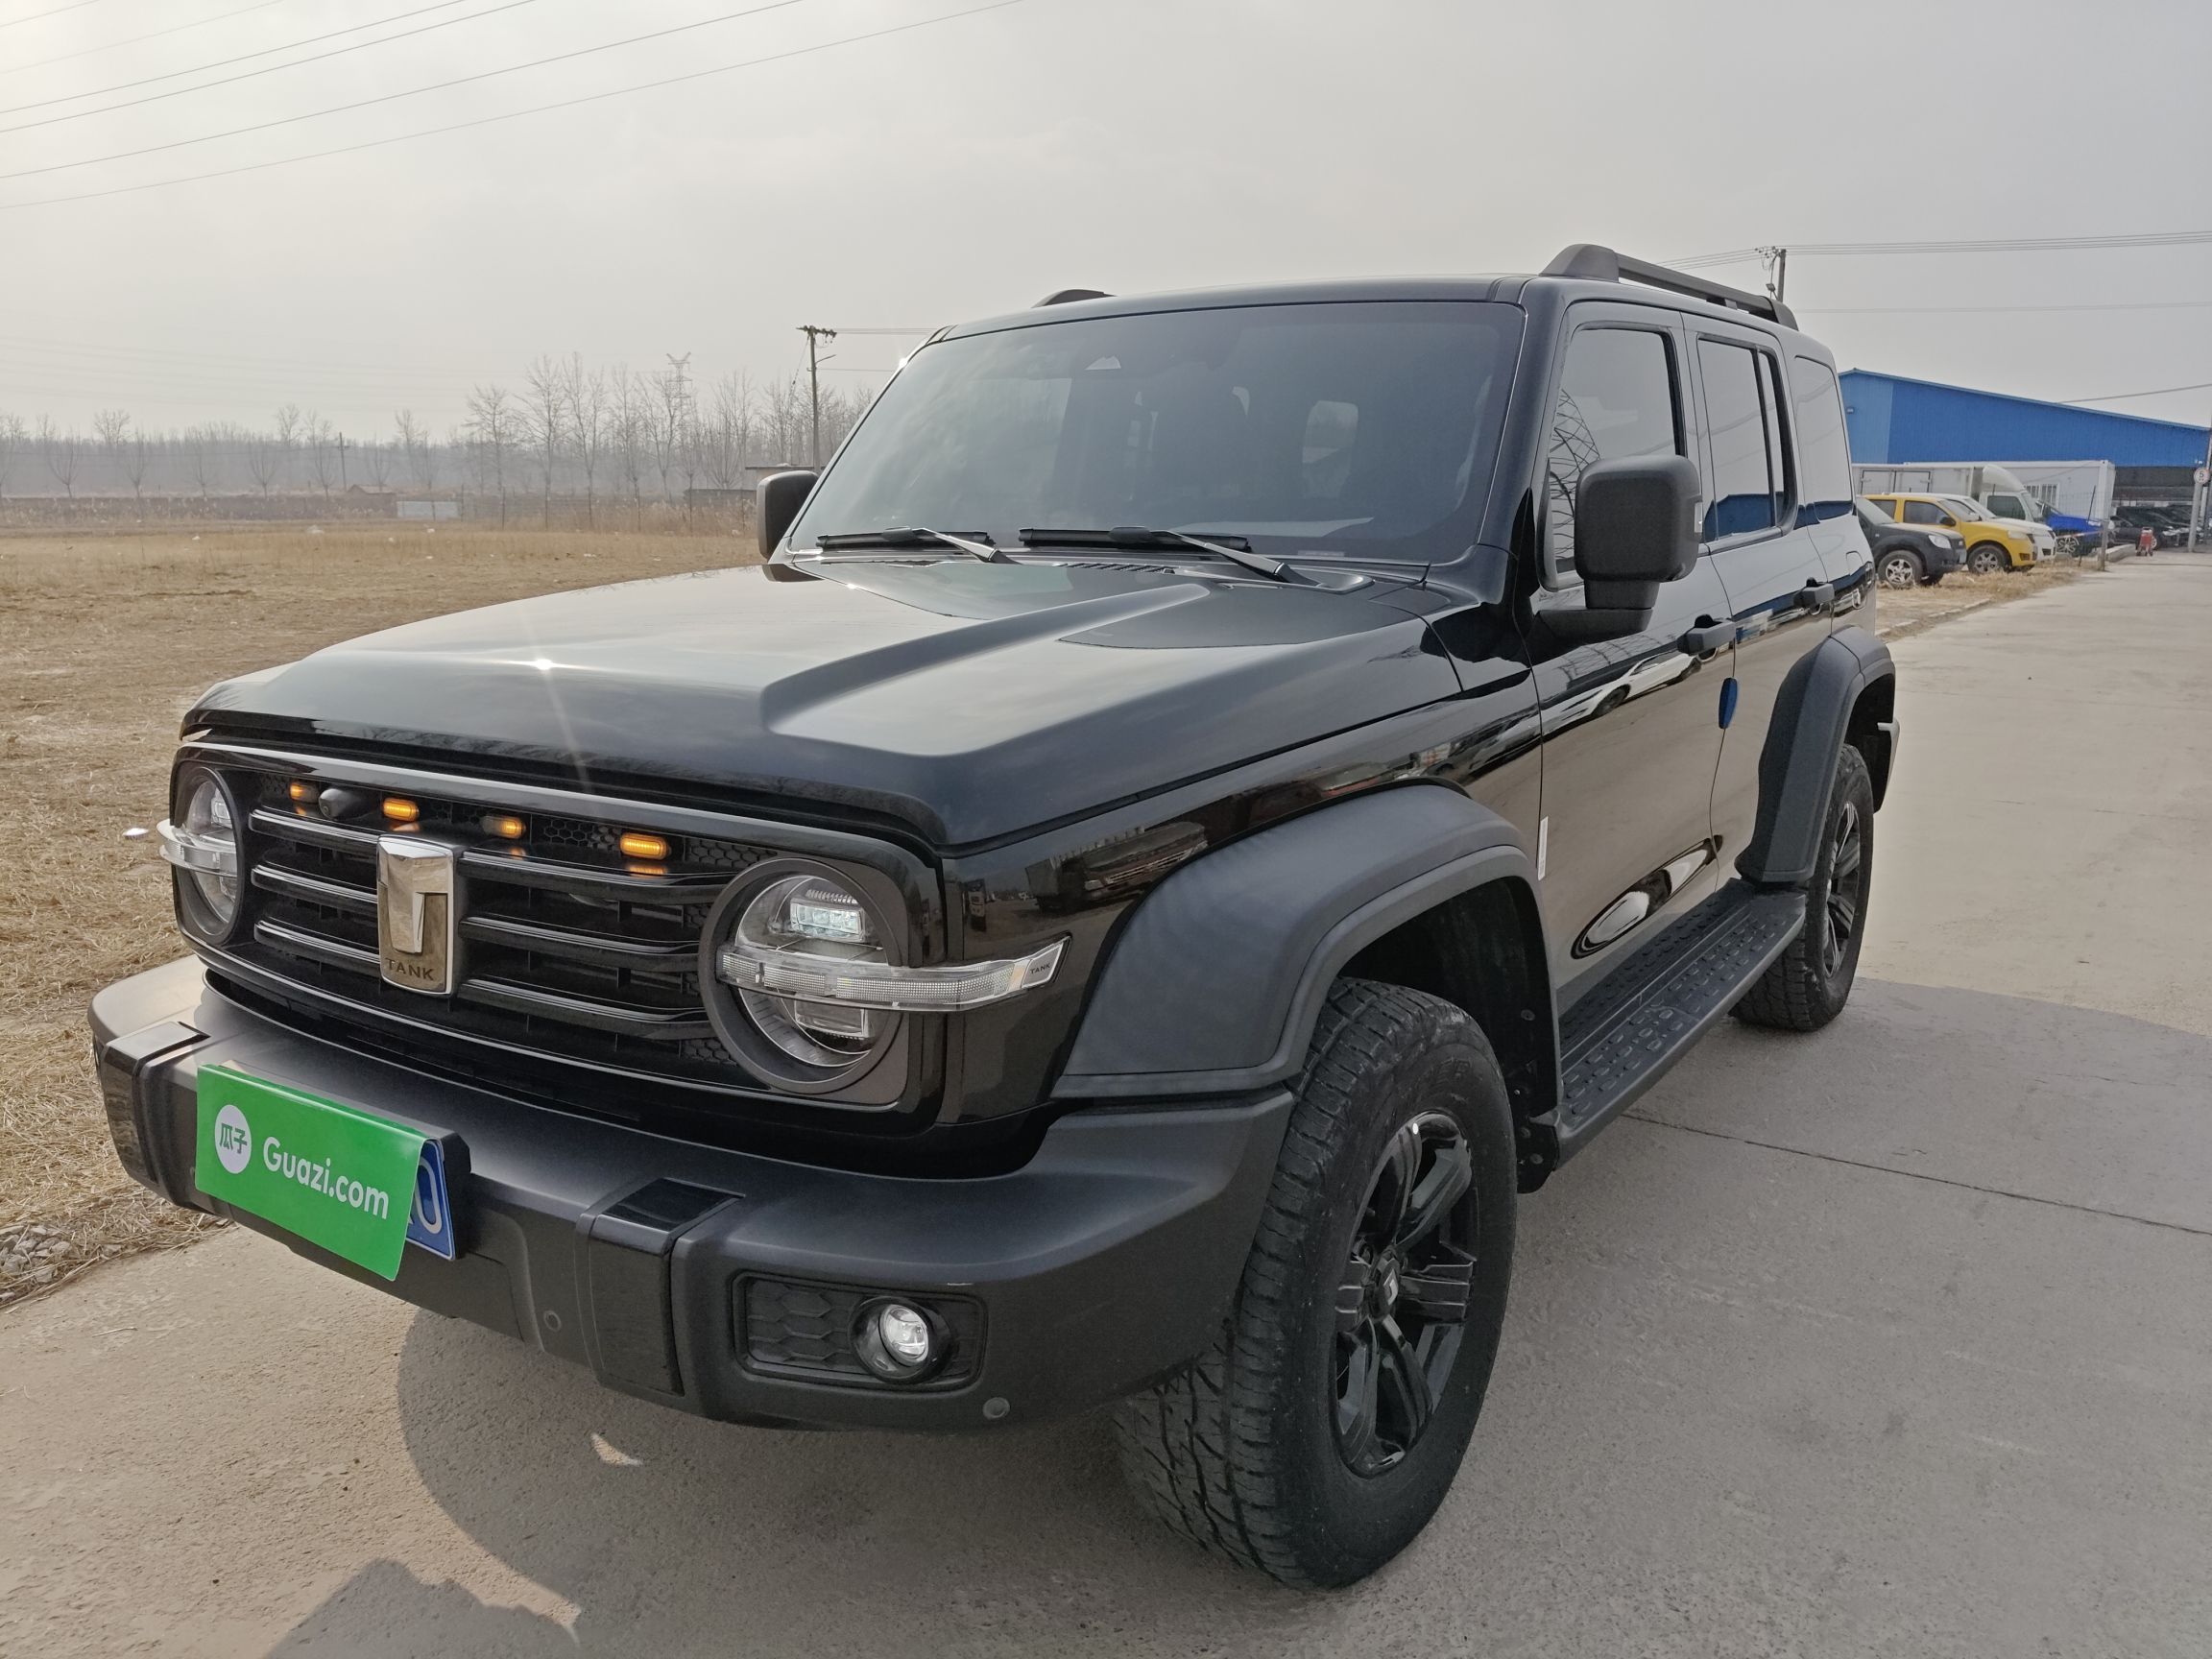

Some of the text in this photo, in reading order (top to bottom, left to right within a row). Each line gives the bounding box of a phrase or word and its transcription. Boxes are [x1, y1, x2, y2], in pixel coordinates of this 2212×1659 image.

[386, 957, 435, 981] TANK
[1030, 962, 1051, 974] TANK
[219, 1121, 248, 1155] 瓜子
[262, 1136, 390, 1220] Guazi.com
